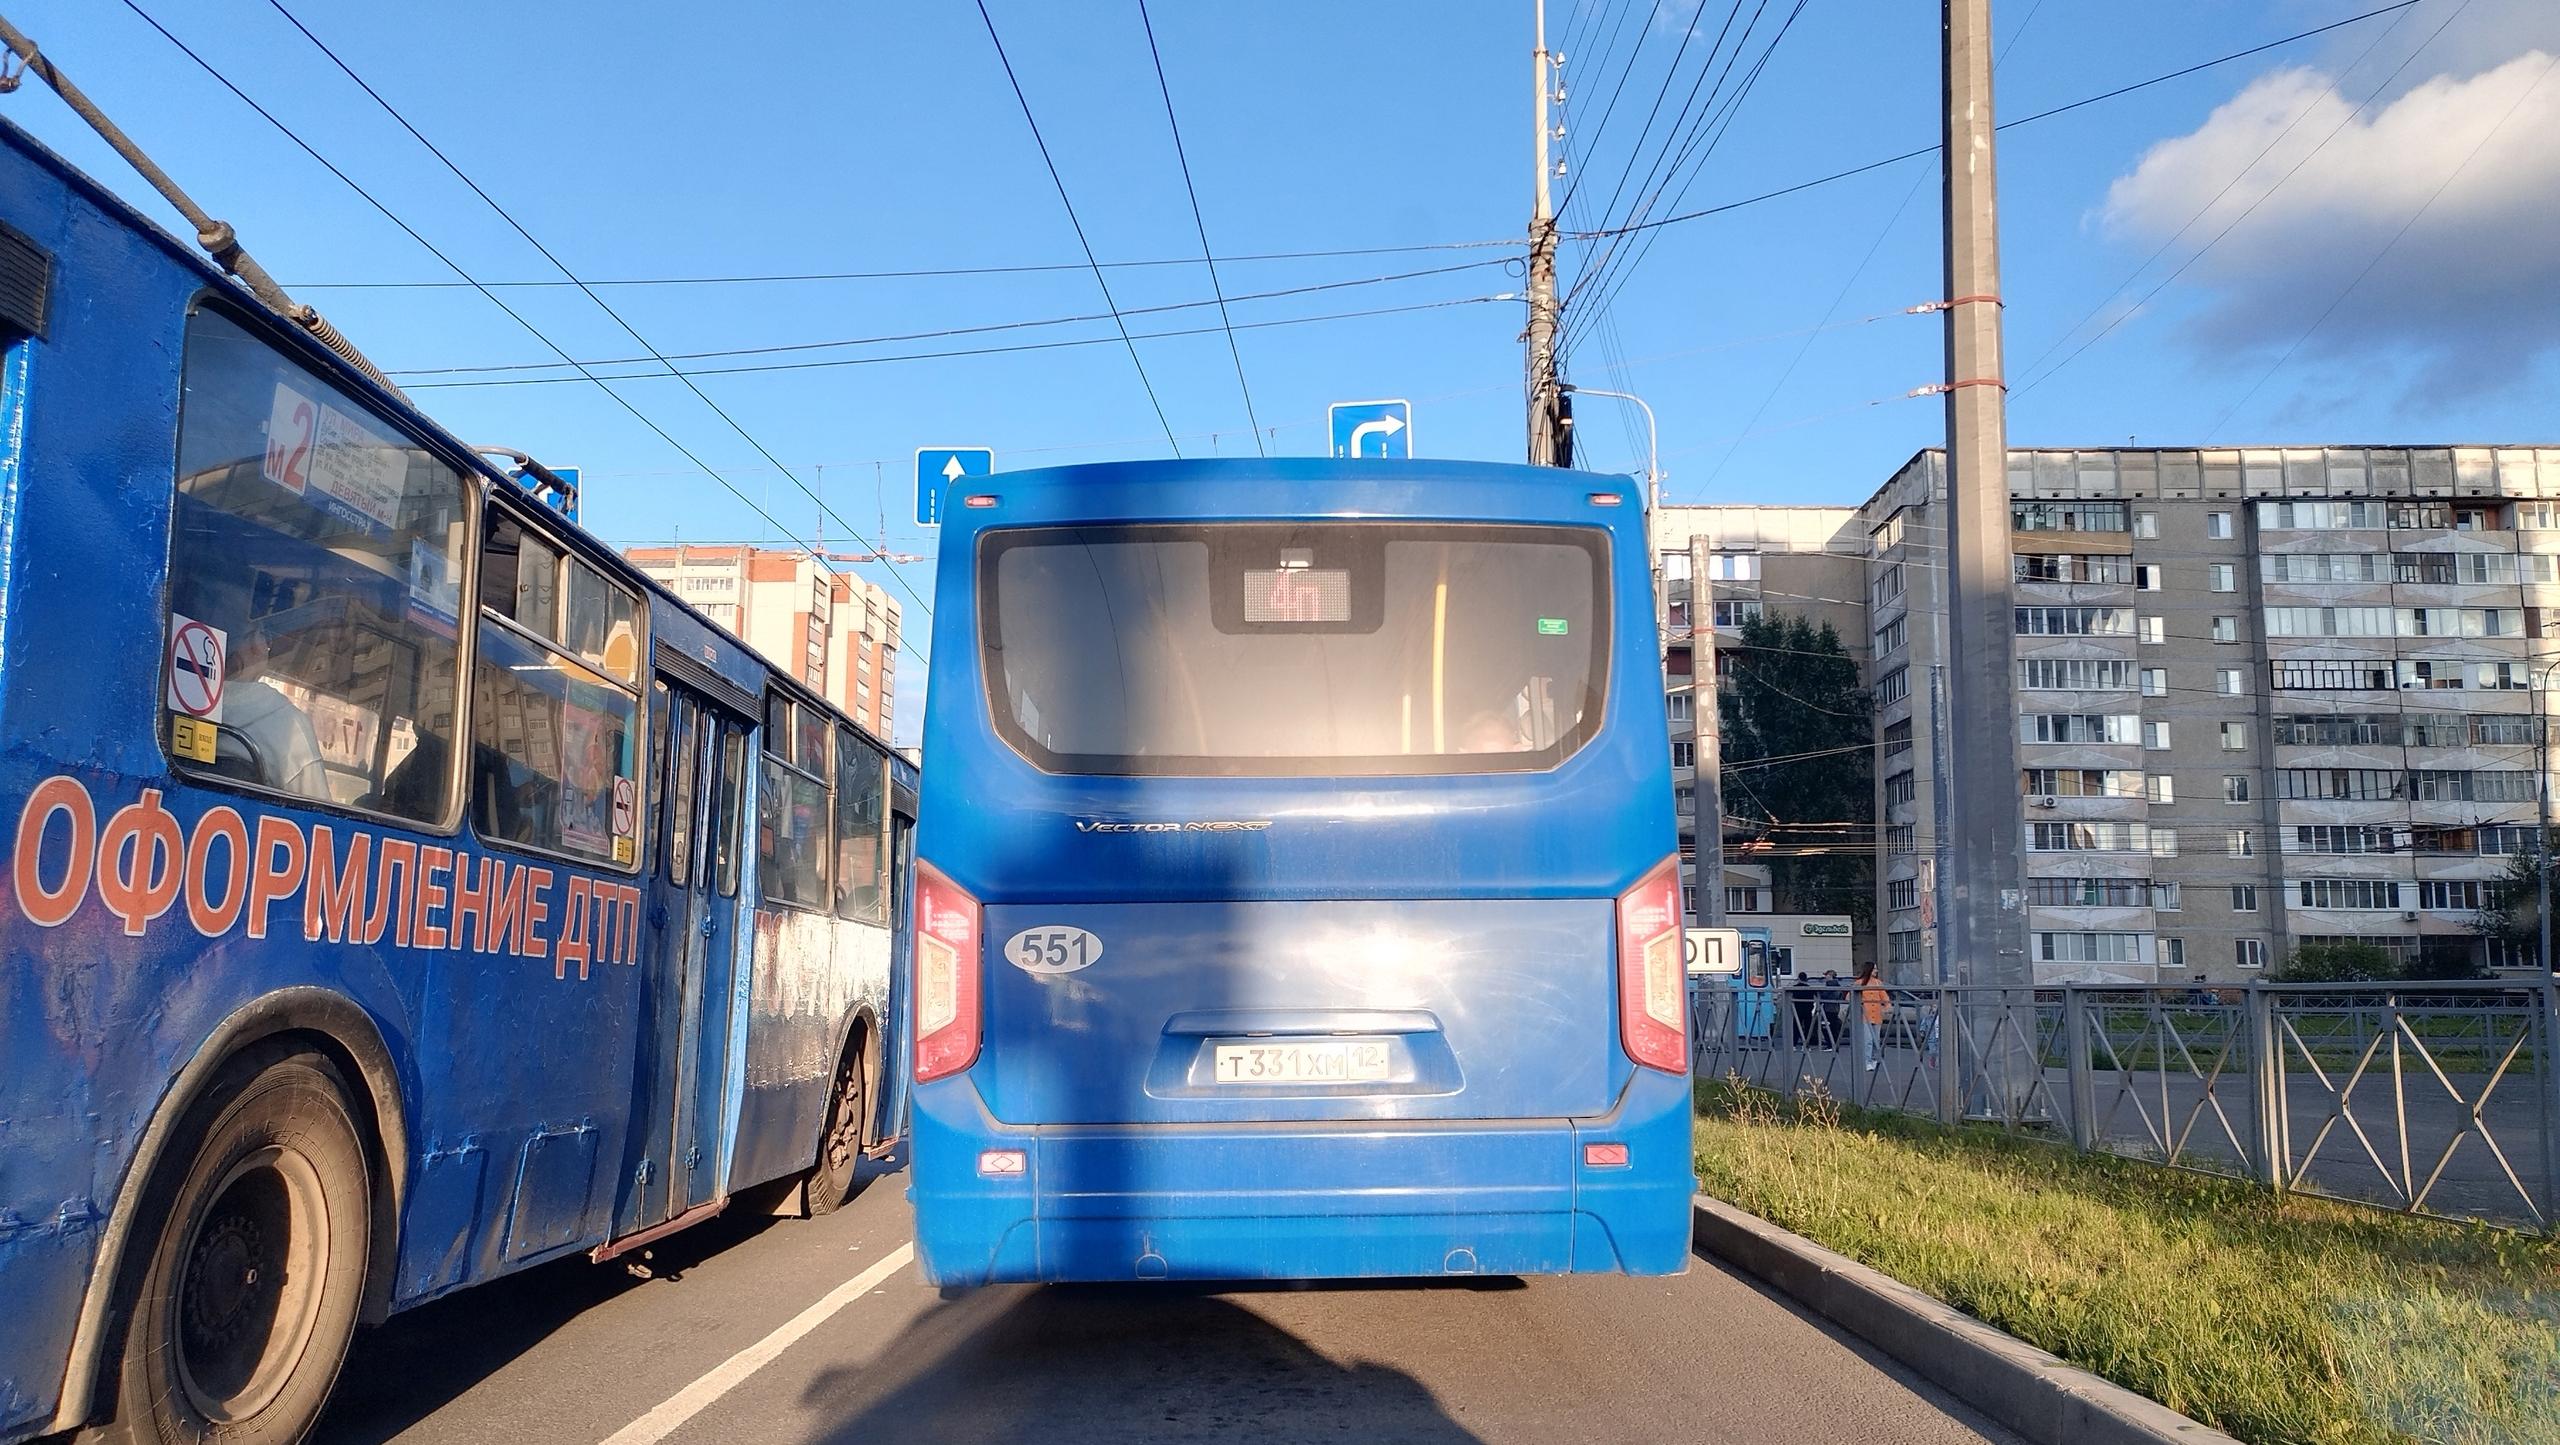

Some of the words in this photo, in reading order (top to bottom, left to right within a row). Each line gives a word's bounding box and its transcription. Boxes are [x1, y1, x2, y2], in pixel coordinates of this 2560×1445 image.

[329, 481, 376, 514] ДЕВЯТЫЙ
[1076, 821, 1181, 834] VECTOR
[13, 774, 552, 957] ОФОРМЛЕНИЕ
[555, 875, 641, 980] ДТП
[1021, 932, 1087, 967] 551
[1229, 1049, 1344, 1078] Т331ХМ
[1352, 1046, 1379, 1068] 12
